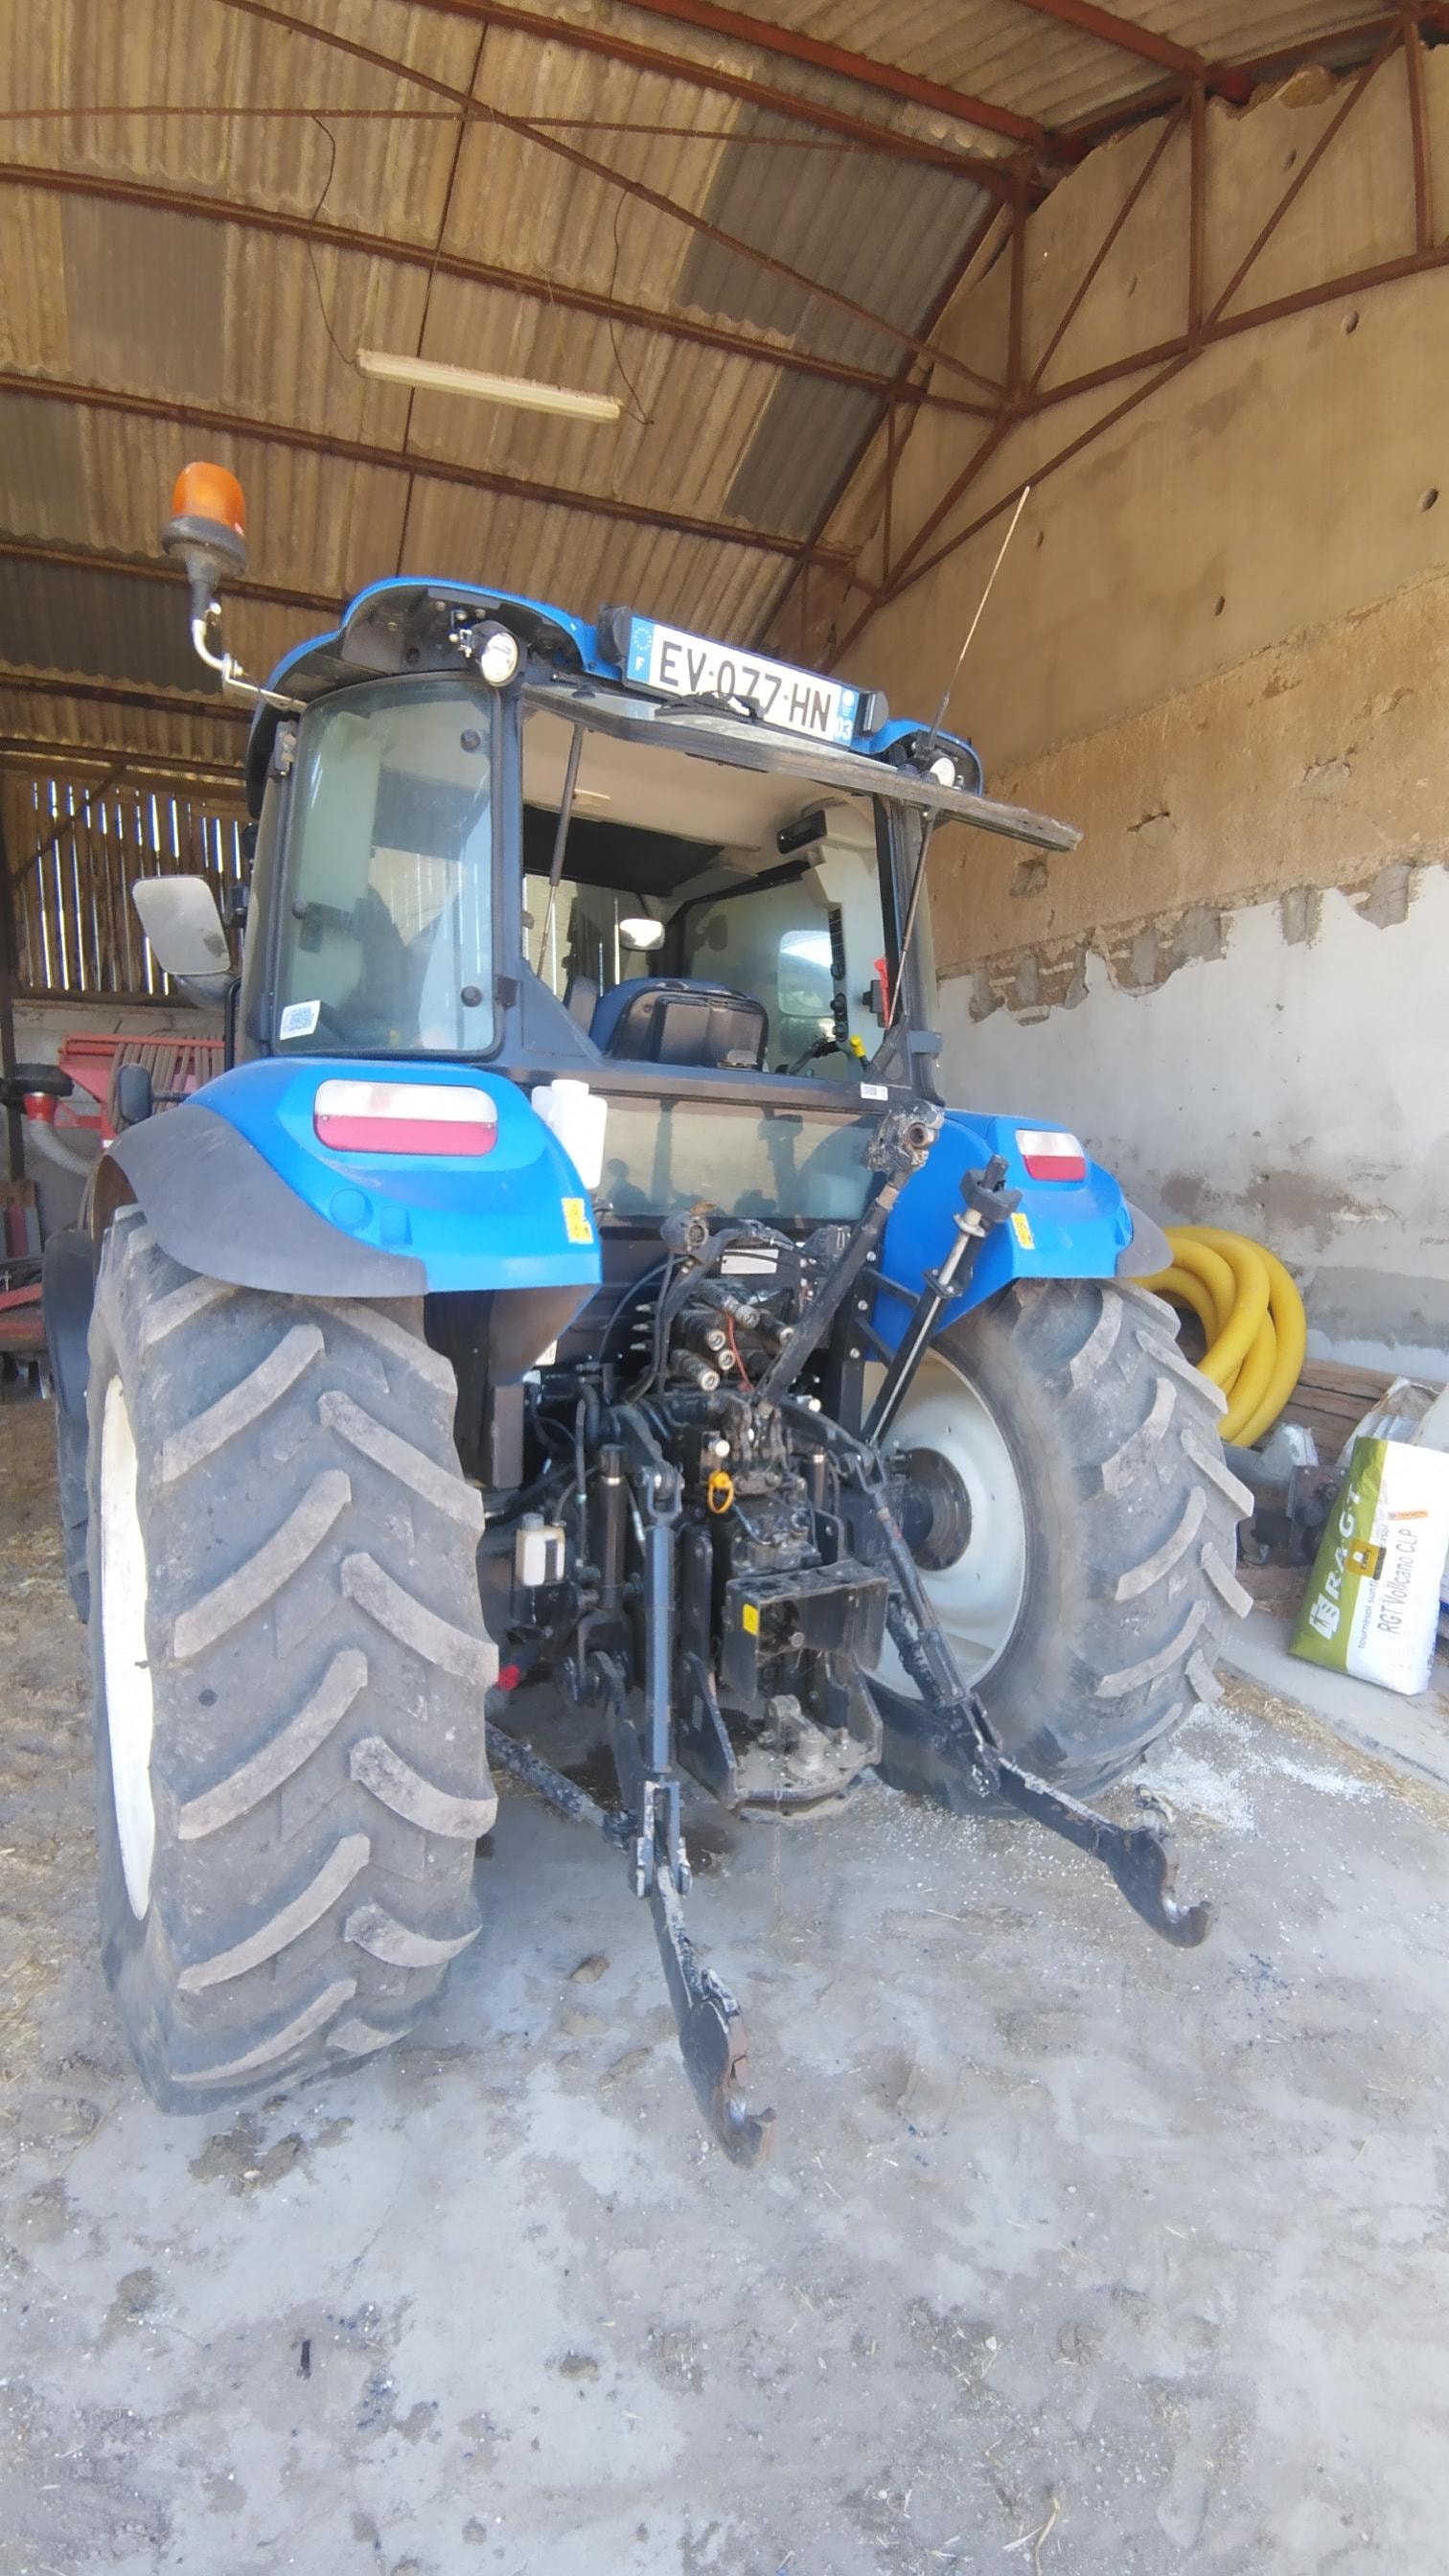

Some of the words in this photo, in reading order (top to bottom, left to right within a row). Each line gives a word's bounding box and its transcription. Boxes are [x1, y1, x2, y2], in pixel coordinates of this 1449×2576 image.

[634, 656, 645, 671] F
[1377, 1605, 1403, 1634] RGT
[1395, 1529, 1417, 1552] CLP
[1358, 1605, 1372, 1649] tournesol
